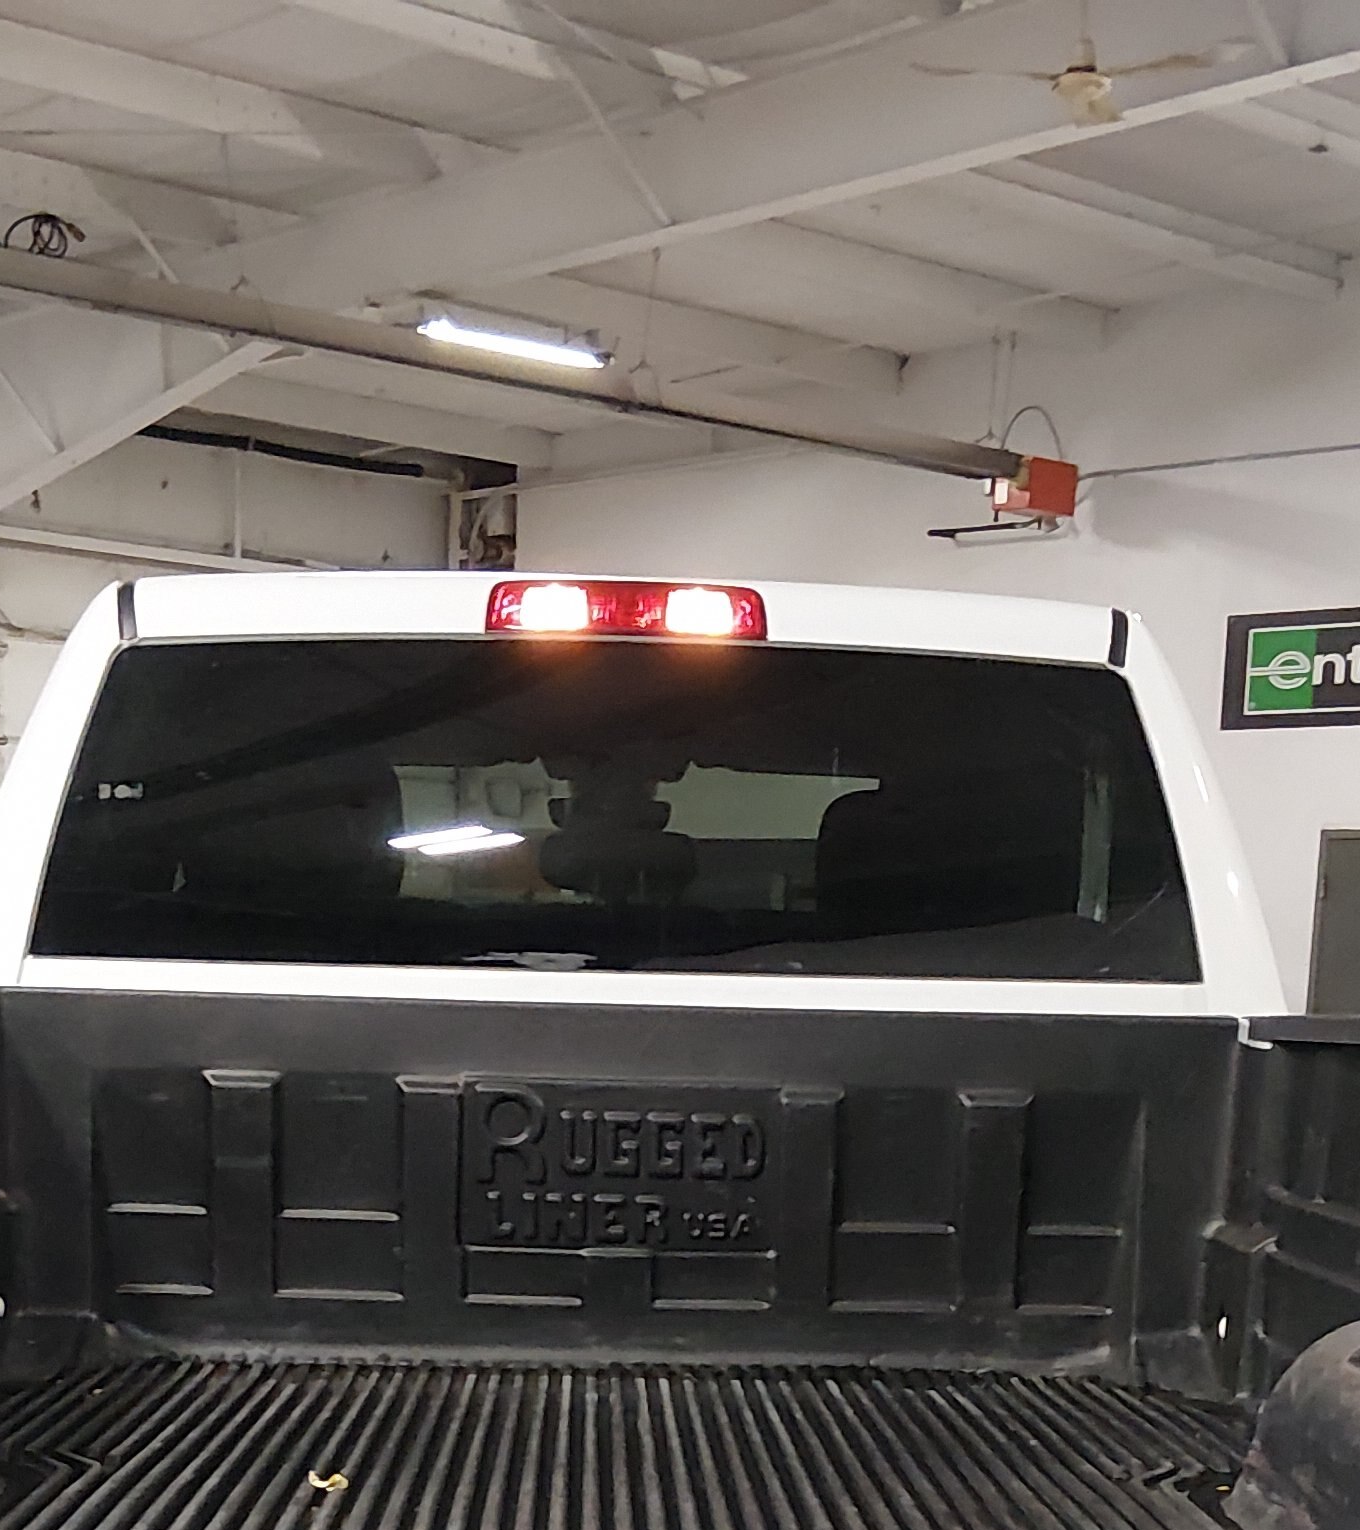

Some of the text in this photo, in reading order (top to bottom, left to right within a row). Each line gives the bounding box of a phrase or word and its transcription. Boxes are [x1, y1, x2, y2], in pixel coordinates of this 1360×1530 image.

[475, 1083, 767, 1184] RUGGED
[486, 1190, 753, 1244] LINER USA
